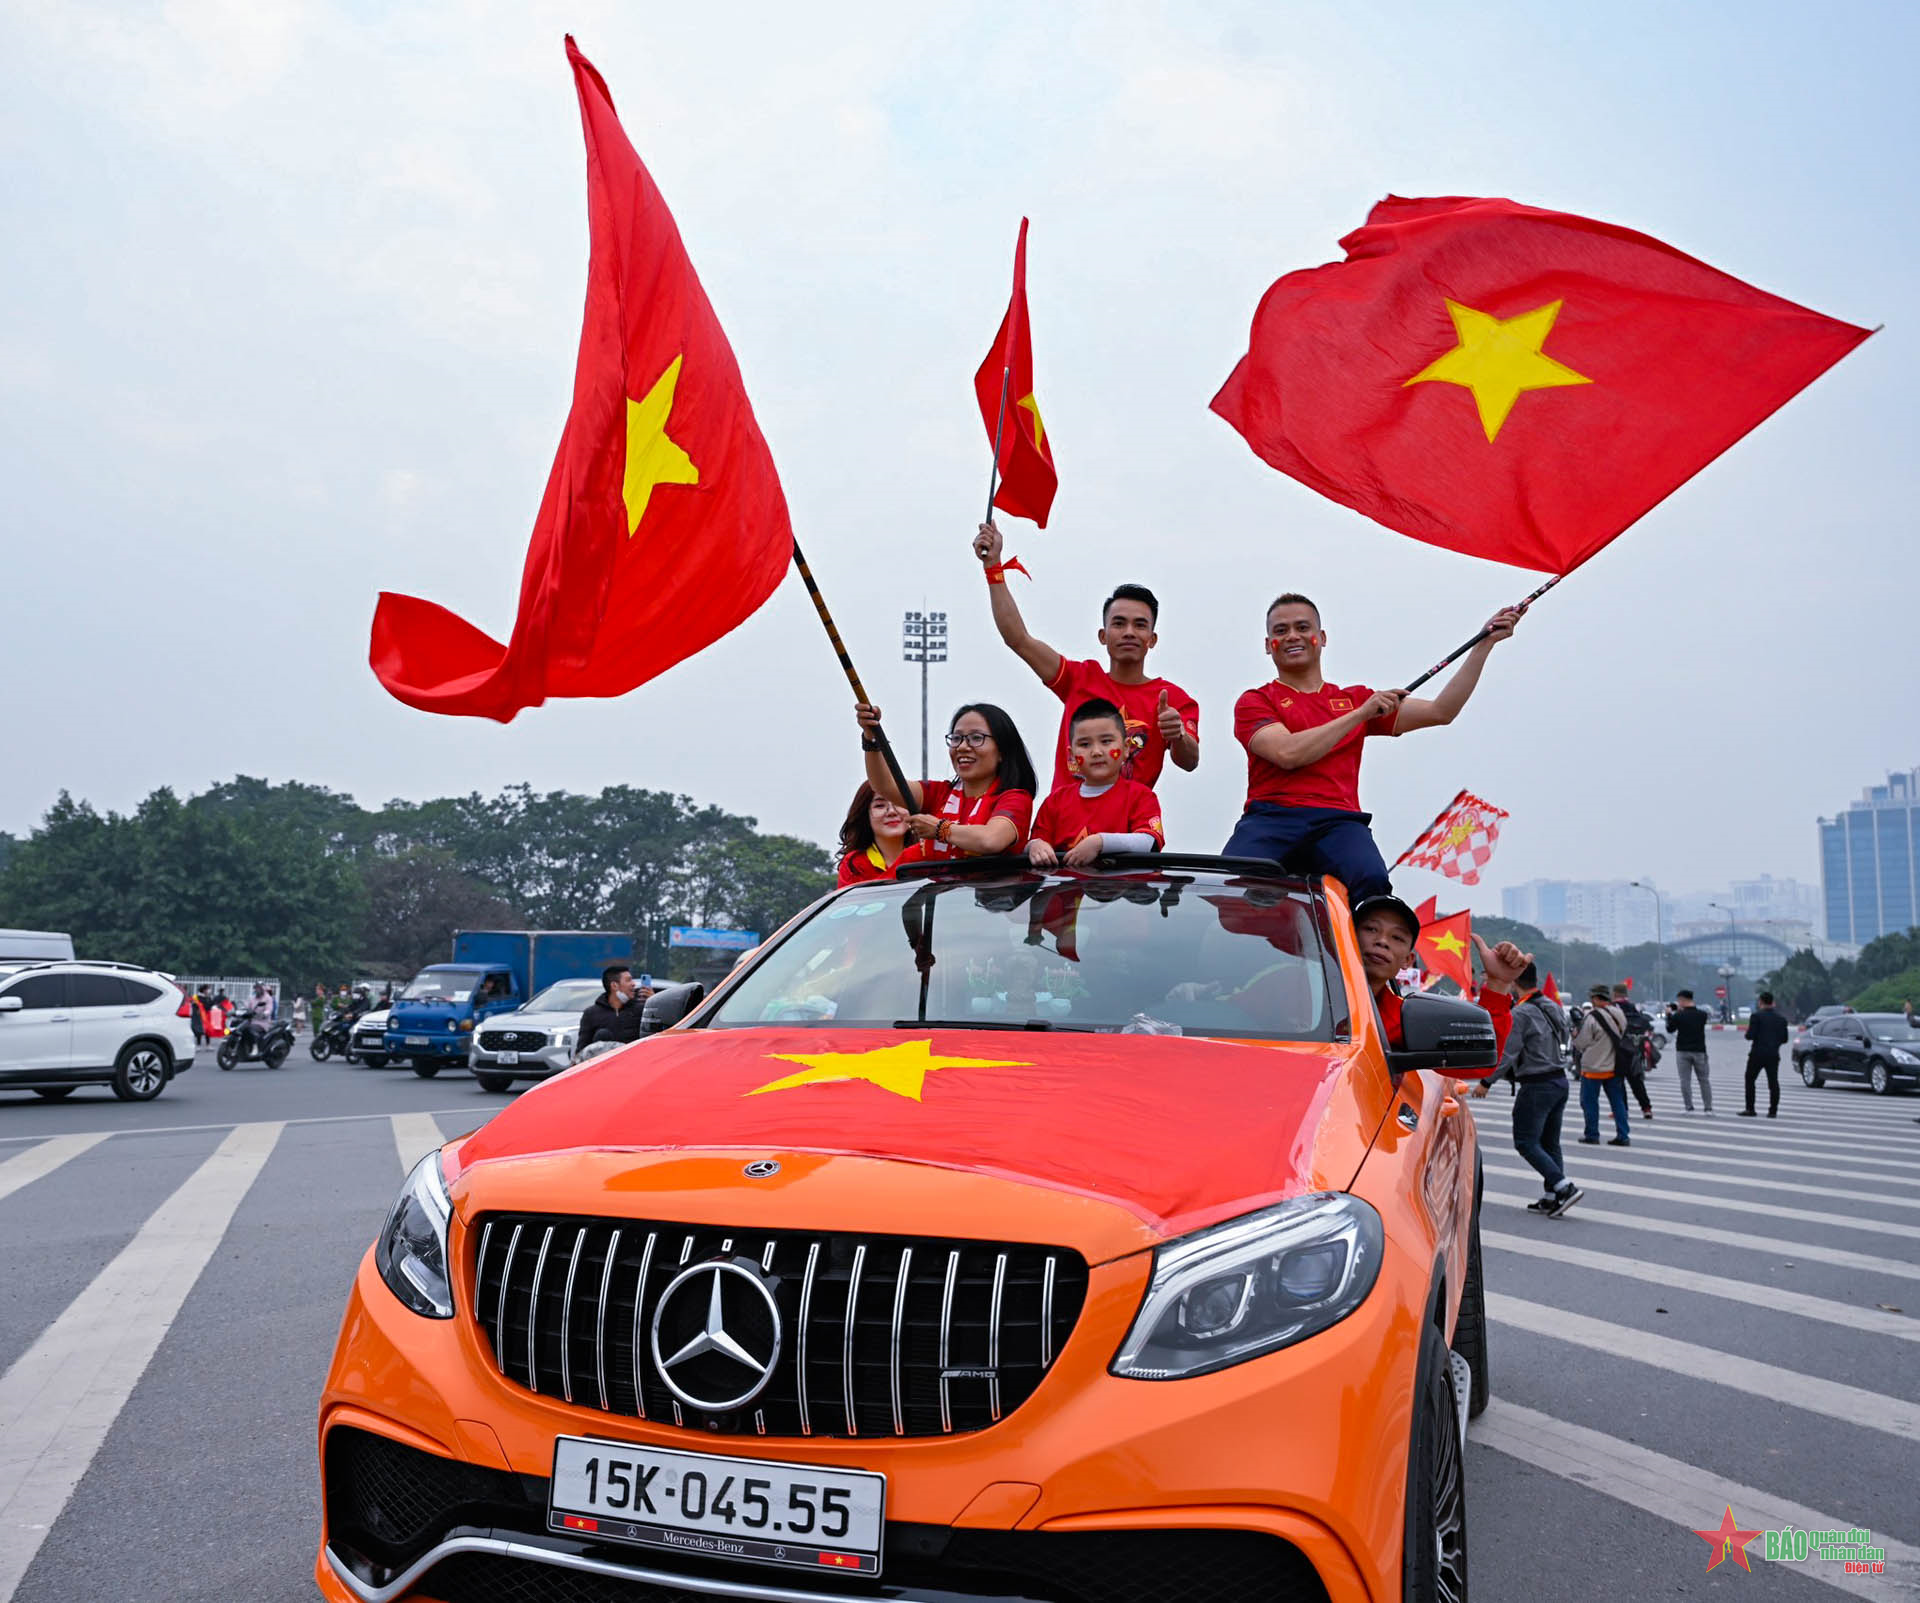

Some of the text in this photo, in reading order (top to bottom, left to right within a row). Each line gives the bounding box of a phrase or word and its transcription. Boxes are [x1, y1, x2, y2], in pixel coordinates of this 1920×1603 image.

[959, 1370, 996, 1378] AMG
[584, 1457, 851, 1538] 15K-045.55
[662, 1531, 744, 1554] Mercedes-Benz
